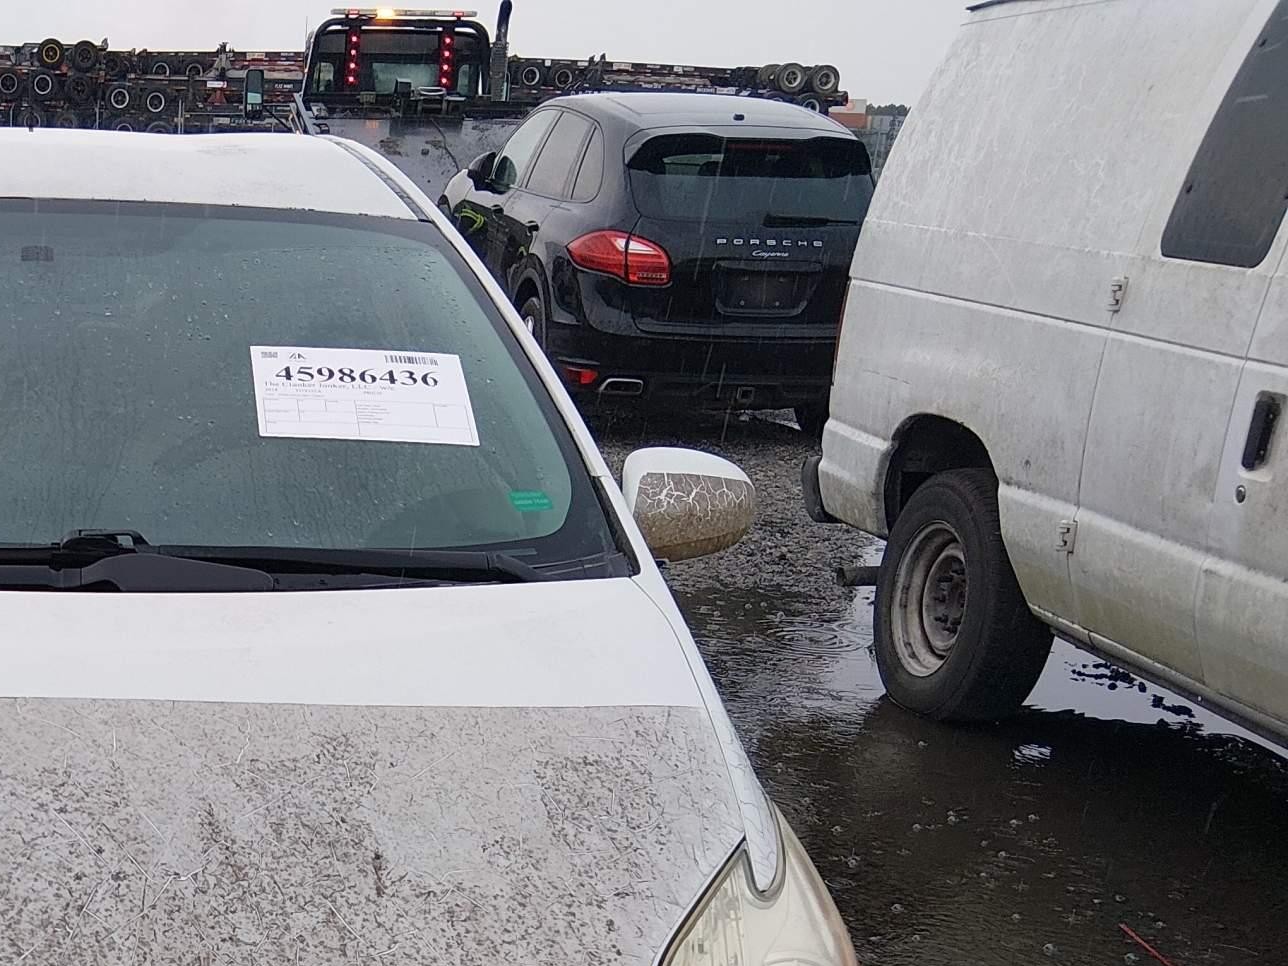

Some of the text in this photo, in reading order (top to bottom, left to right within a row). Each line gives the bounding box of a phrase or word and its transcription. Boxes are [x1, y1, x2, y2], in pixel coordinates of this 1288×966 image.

[716, 238, 823, 247] PORSCHE
[751, 249, 790, 260] Cayenne
[274, 365, 440, 388] 45986436
